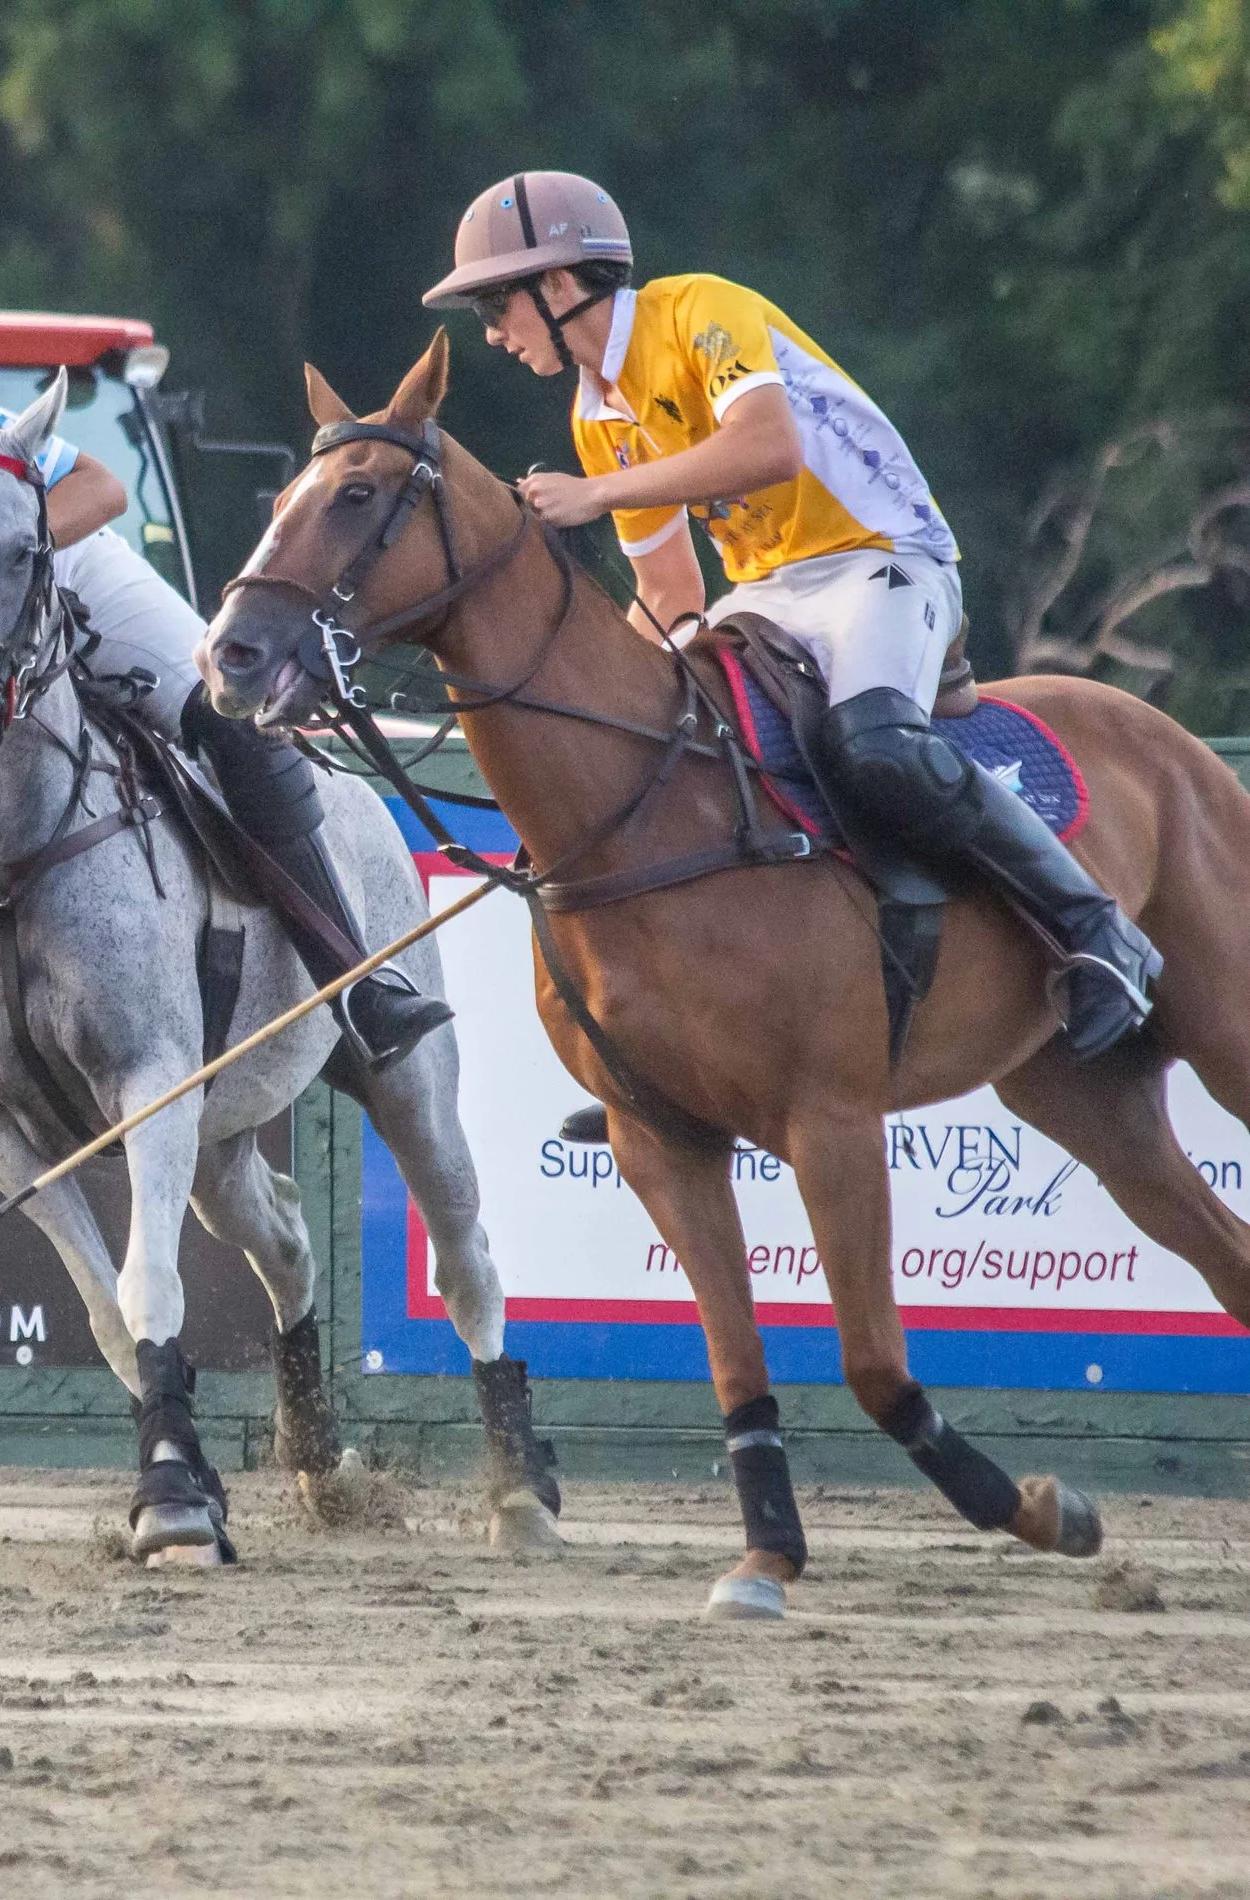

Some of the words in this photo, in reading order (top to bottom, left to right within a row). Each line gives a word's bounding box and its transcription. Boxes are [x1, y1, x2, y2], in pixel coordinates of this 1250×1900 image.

[735, 1144, 782, 1183] he
[888, 1124, 1023, 1172] RVEN
[935, 1156, 1080, 1219] Park
